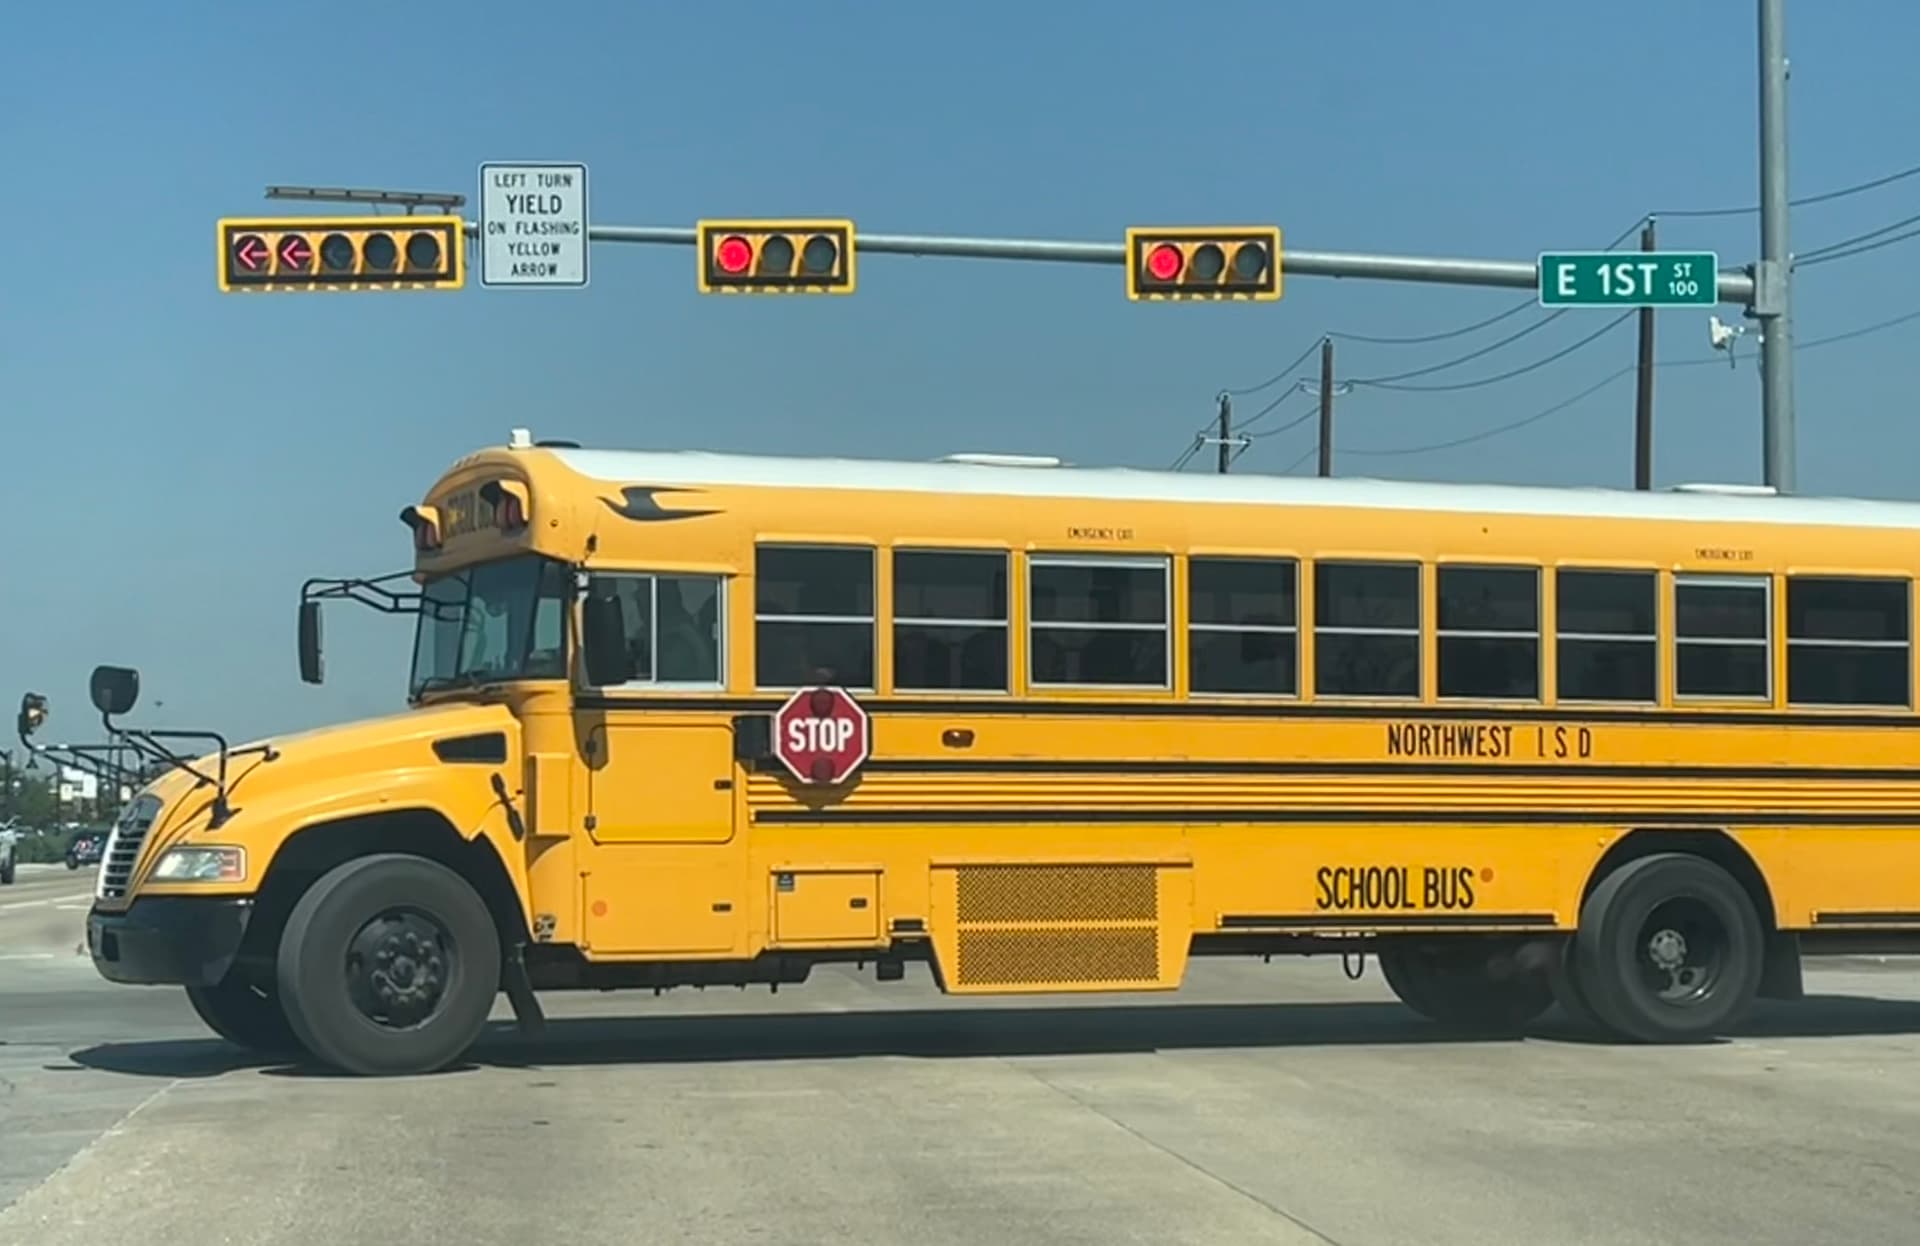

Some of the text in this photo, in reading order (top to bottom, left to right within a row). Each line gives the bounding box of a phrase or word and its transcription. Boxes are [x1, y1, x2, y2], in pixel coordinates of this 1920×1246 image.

[494, 173, 573, 188] LEFT TURN
[506, 194, 563, 215] YIELD
[487, 221, 580, 236] ON FLASHING
[508, 242, 561, 256] YELLOW
[511, 262, 558, 277] ARROW
[1673, 263, 1692, 278] ST
[1558, 263, 1658, 296] E 1ST
[1668, 281, 1698, 295] 100
[788, 717, 854, 753] STOP
[1388, 723, 1512, 758] NORTHWEST
[1316, 866, 1474, 910] SCHOOL BUS
